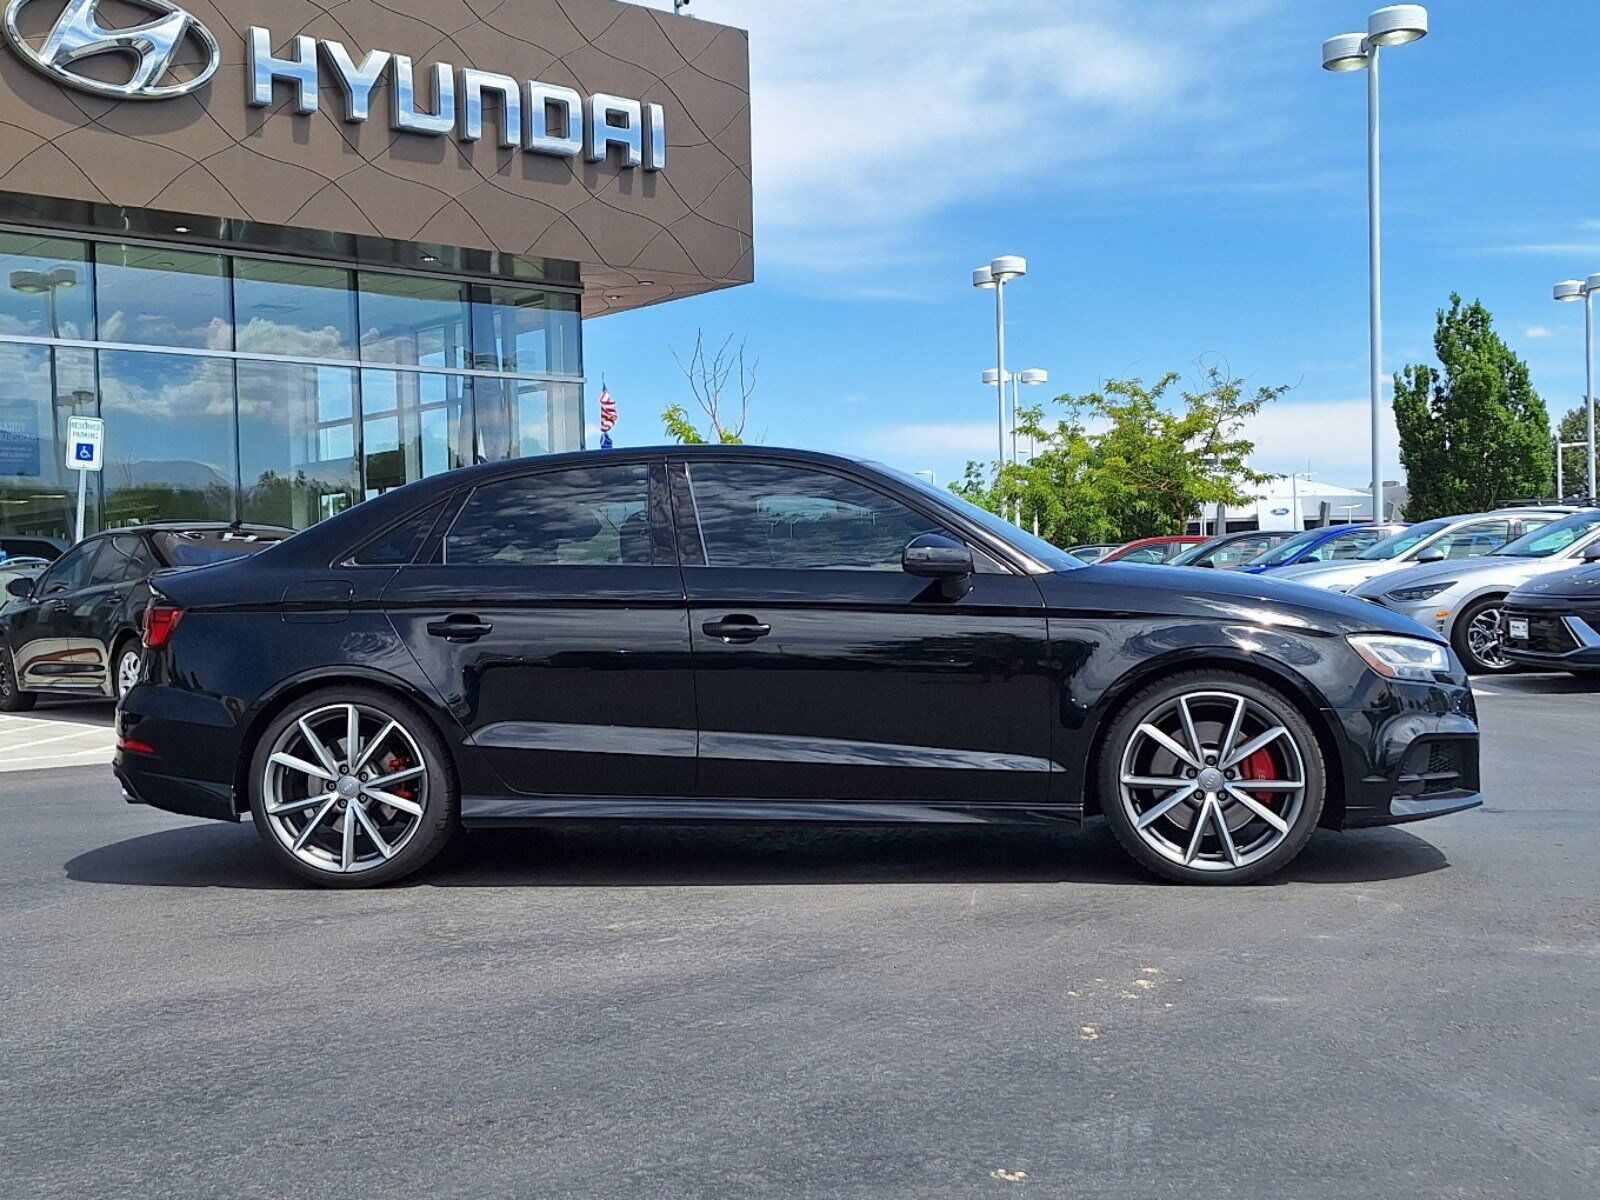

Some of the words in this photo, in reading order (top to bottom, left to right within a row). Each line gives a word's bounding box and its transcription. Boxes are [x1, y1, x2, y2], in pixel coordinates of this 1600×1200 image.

[246, 26, 667, 172] HYUNDAI
[71, 421, 101, 431] RESERVED
[72, 431, 99, 440] PARKING
